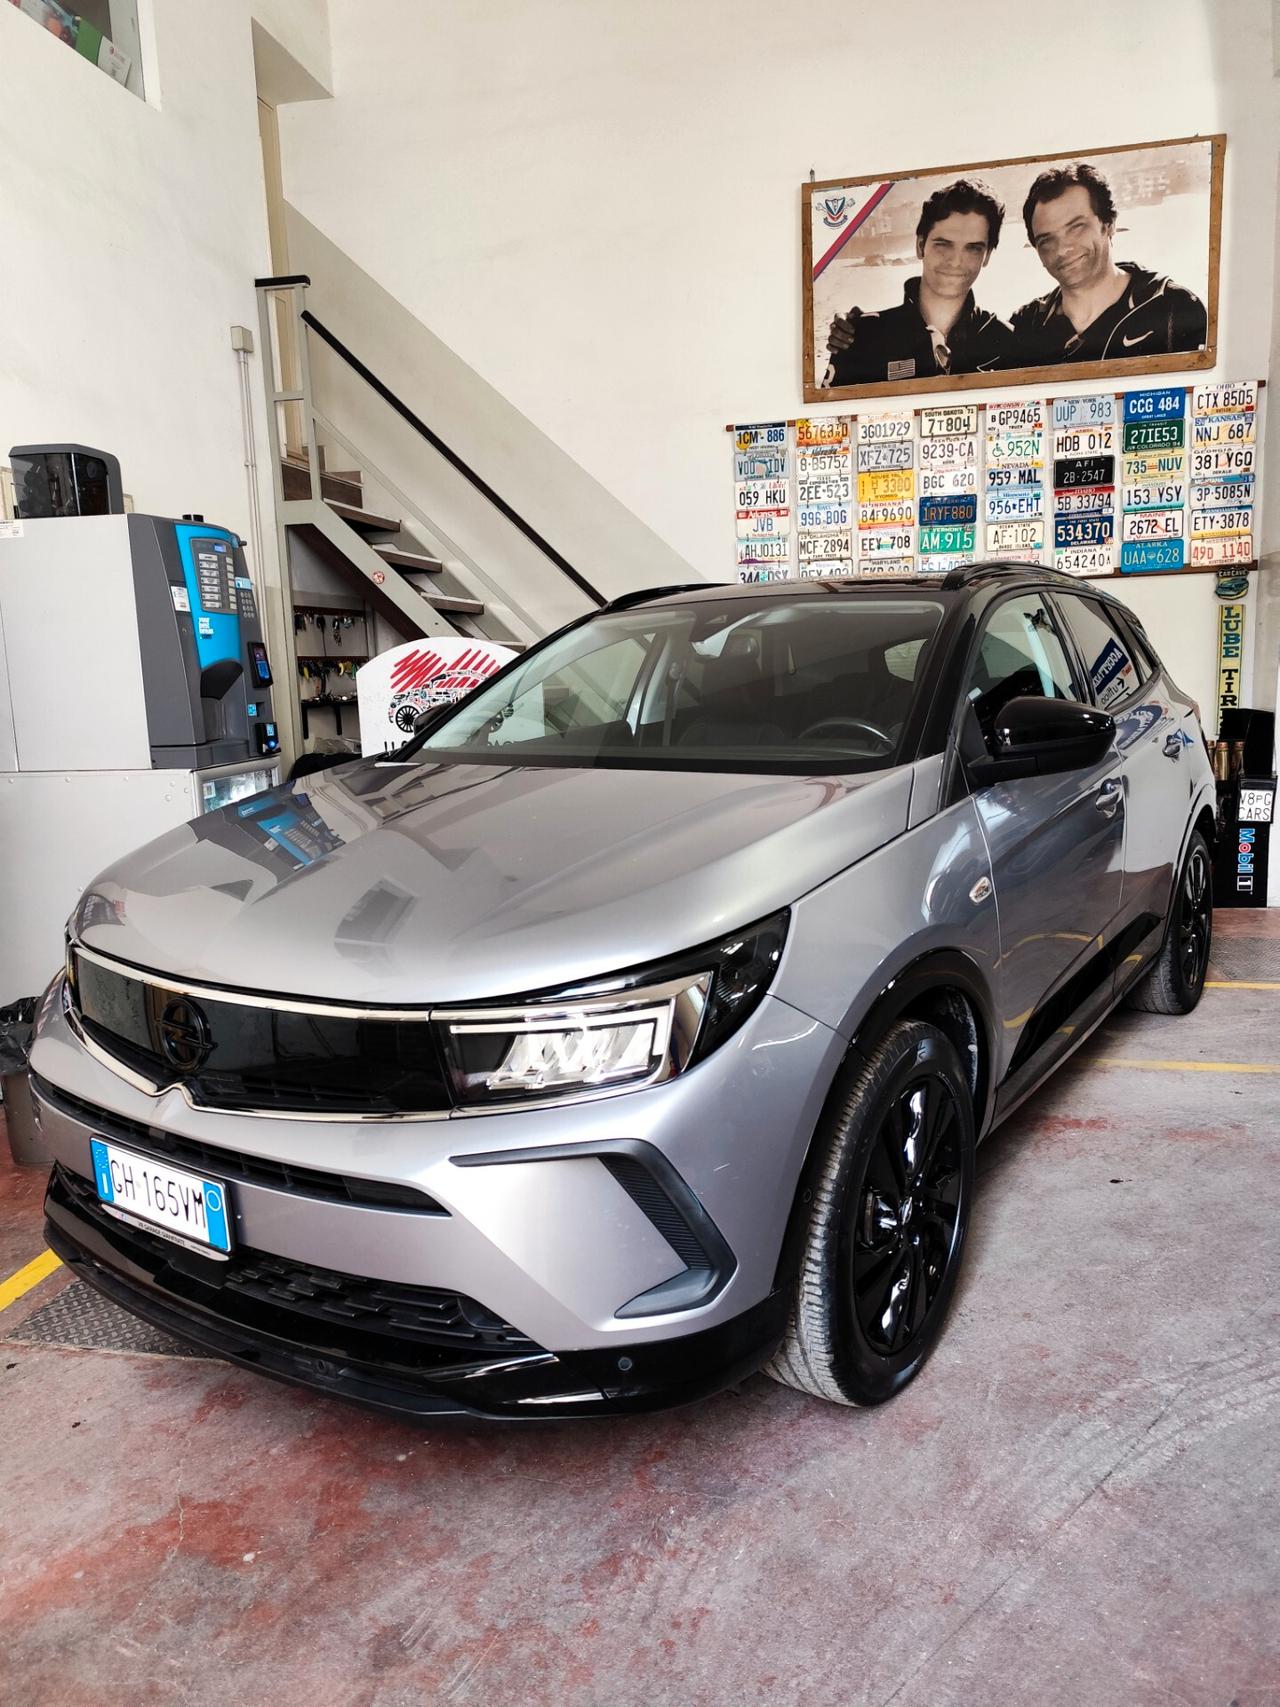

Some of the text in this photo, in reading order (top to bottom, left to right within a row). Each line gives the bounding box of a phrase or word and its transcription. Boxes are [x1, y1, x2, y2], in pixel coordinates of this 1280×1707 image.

[1129, 396, 1180, 414] CCG 484
[1197, 389, 1254, 410] CTX 8505
[1056, 401, 1112, 422] UUP 983
[1208, 413, 1242, 424] KANSAS
[928, 416, 971, 434] 7T804
[1195, 422, 1253, 443] NNJ 687
[1007, 439, 1040, 457] 952N
[1056, 432, 1112, 453] HDB 012
[1136, 442, 1171, 450] COLORADO
[889, 447, 911, 465] 725
[1075, 460, 1094, 468] AFI
[1194, 453, 1219, 471] 381
[1001, 462, 1029, 470] NEVADA
[1126, 456, 1183, 475] 735 NUV
[923, 473, 974, 490] BGC 620
[739, 489, 786, 506] 059 HKU
[1057, 492, 1112, 511] 5B 33794
[1126, 485, 1182, 506] 153 YSY
[923, 505, 974, 522] 1RYF880
[989, 497, 1041, 515] 956 EHT
[752, 517, 774, 533] JVB
[1057, 521, 1110, 542] 534370
[1130, 517, 1179, 536] 2672 EL
[861, 535, 911, 552] EEY 708
[1221, 541, 1251, 559] 1140
[1124, 547, 1180, 566] UAA 628
[1222, 606, 1241, 658] LUBE
[1238, 807, 1270, 821] CARS
[1237, 828, 1255, 874] Mobil
[110, 1159, 207, 1229] GH 165VM
